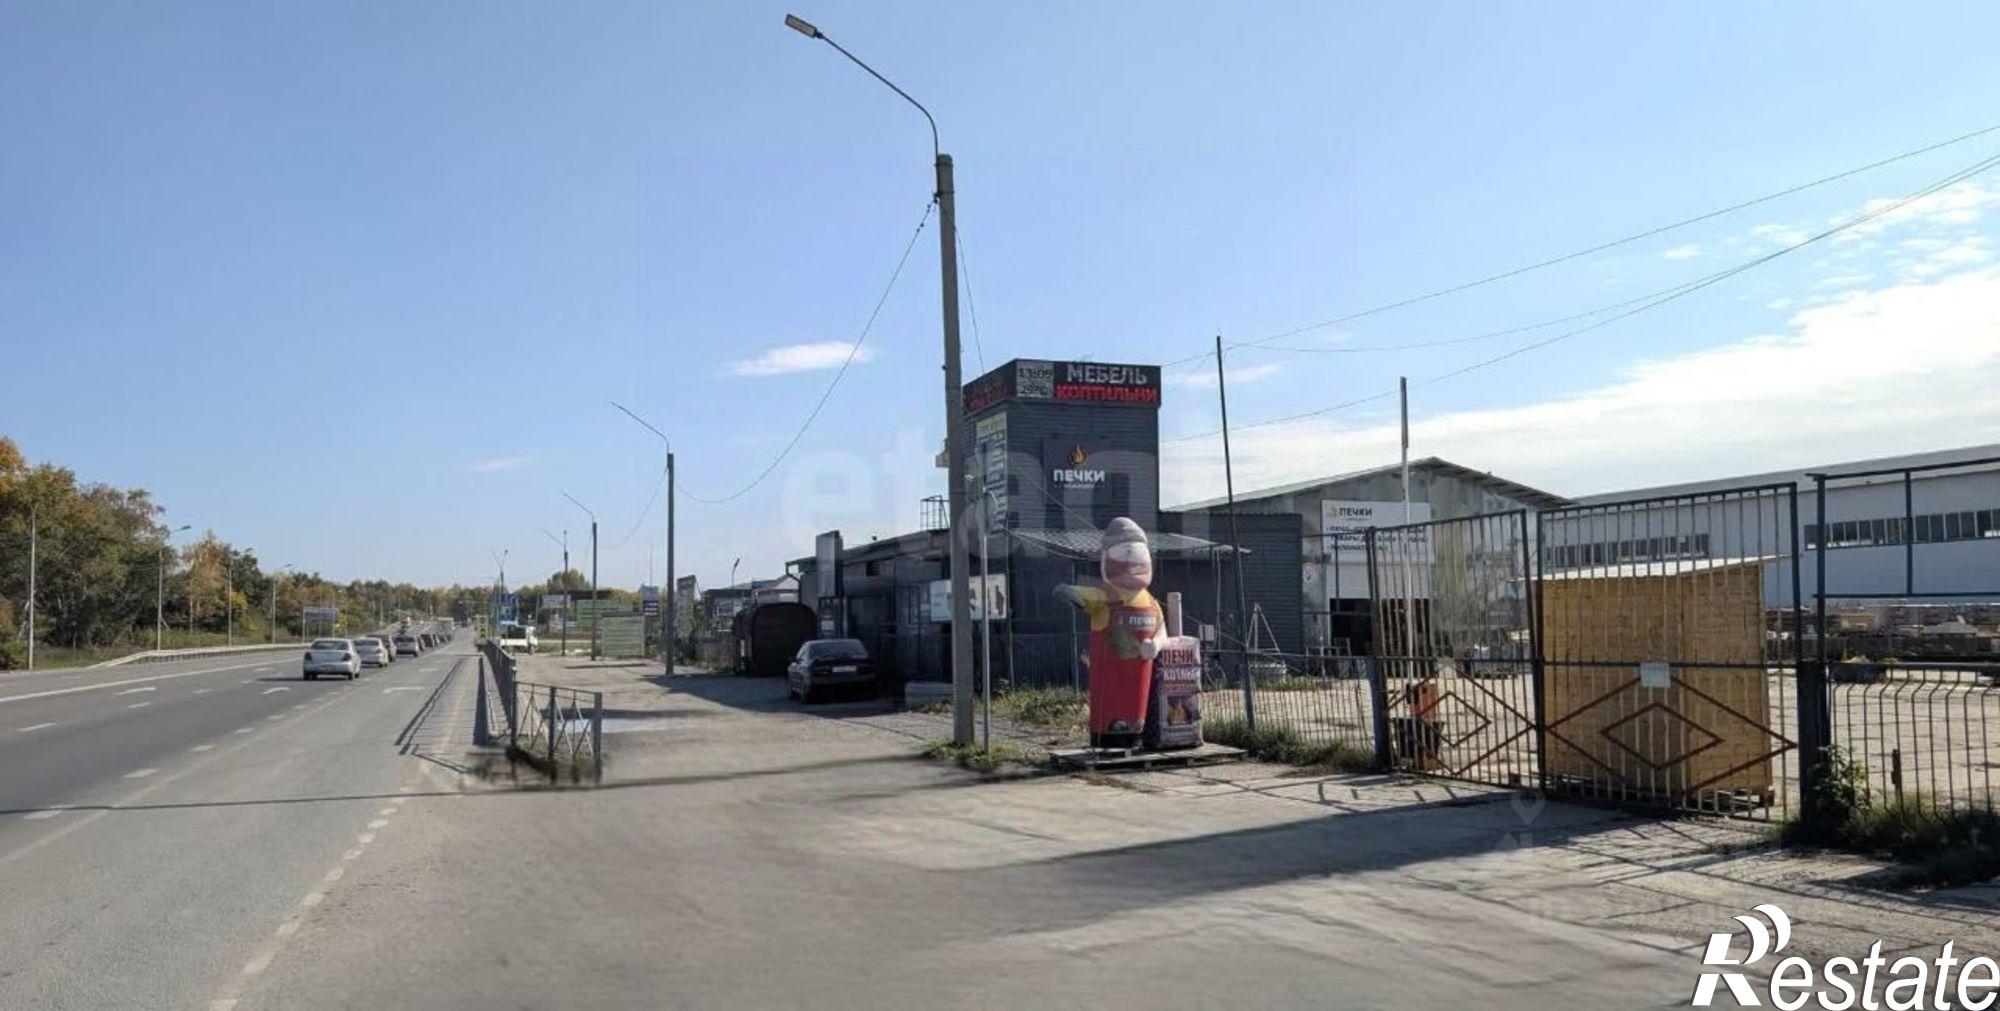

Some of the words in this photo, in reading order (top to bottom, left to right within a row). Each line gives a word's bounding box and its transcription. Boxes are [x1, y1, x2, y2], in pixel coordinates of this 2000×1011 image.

[1066, 363, 1148, 385] МЕБЕЛЬ
[1055, 383, 1157, 402] КОПТИЛЬНИ
[1053, 468, 1106, 483] ПЕЧКИ
[1339, 507, 1373, 517] ПЕЧКИ
